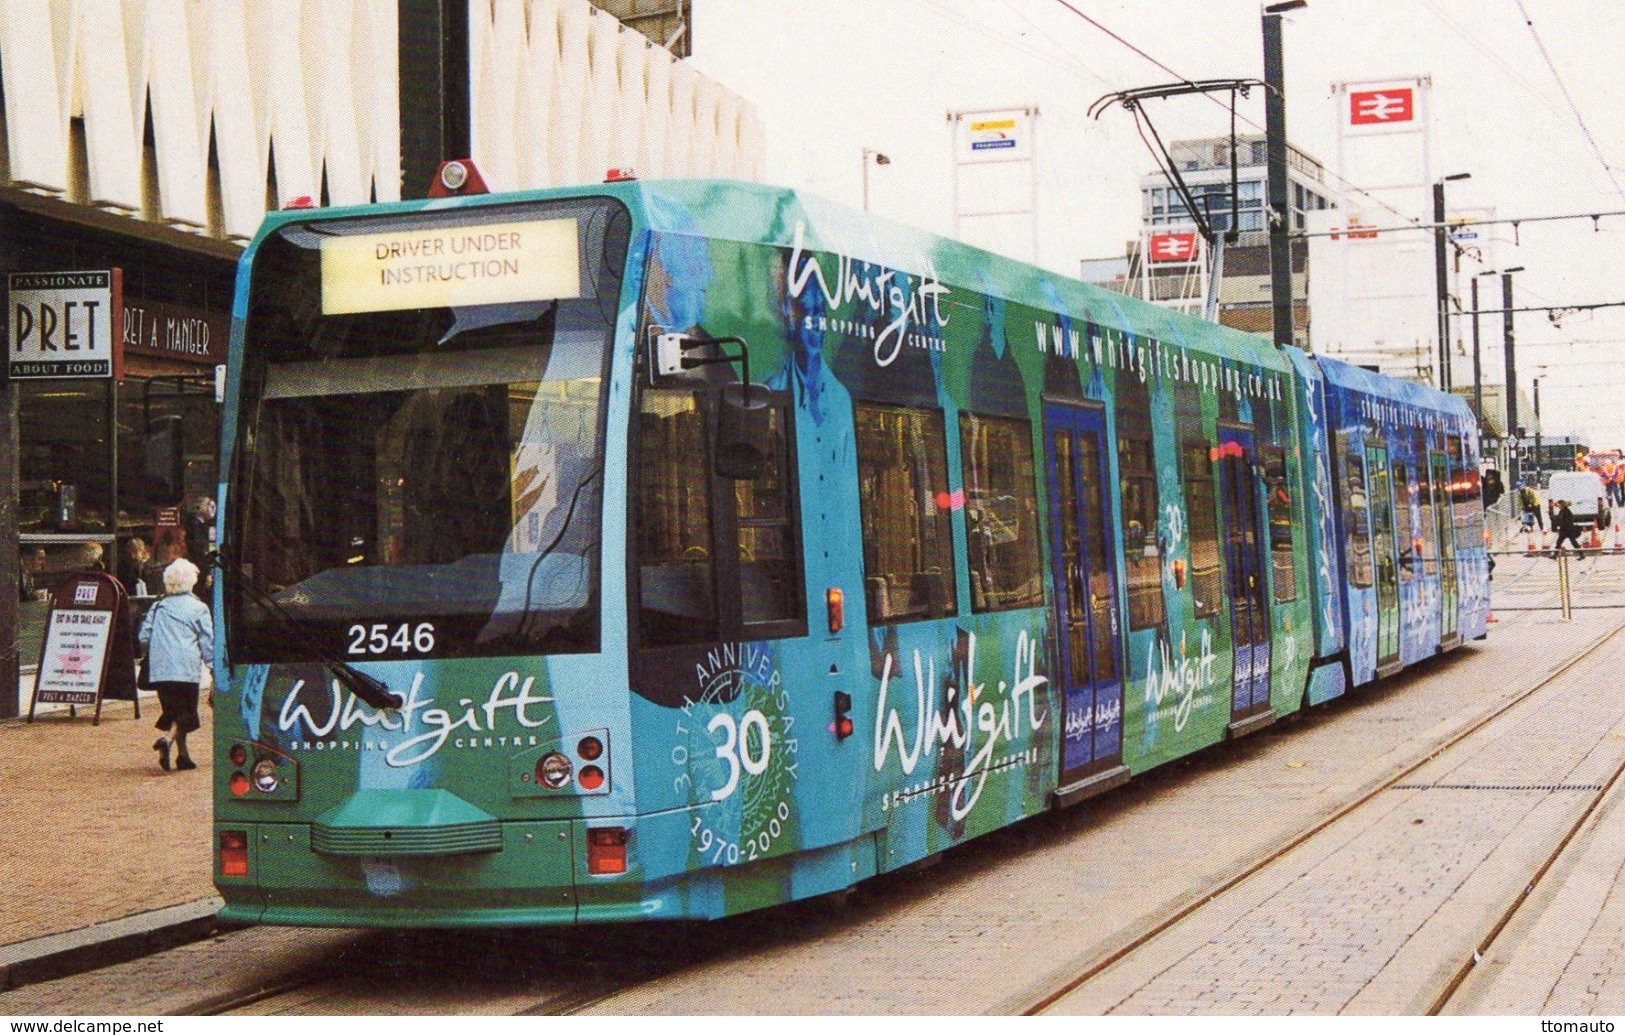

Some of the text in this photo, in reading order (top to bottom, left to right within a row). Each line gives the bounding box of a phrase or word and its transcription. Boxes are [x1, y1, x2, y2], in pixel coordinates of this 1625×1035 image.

[376, 232, 522, 260] DRIVER UNDER
[15, 275, 104, 286] PASSIONATE
[381, 259, 520, 286] INSTRUCTION
[788, 219, 951, 367] Whitgift
[16, 301, 99, 351] PRET
[150, 319, 158, 347] A
[166, 317, 209, 355] MANGER
[12, 363, 107, 374] ABOUT FOOD!
[1035, 321, 1282, 401] www.whitgiftshopping.co.uk
[348, 622, 435, 654] 2546
[1145, 628, 1217, 732] Whitgift
[279, 671, 556, 767] Whitgift
[291, 736, 537, 751] SHOPPING CENTRE
[874, 629, 1048, 821] Whitgift
[707, 710, 770, 801] 30
[690, 802, 789, 864] 1970-2000
